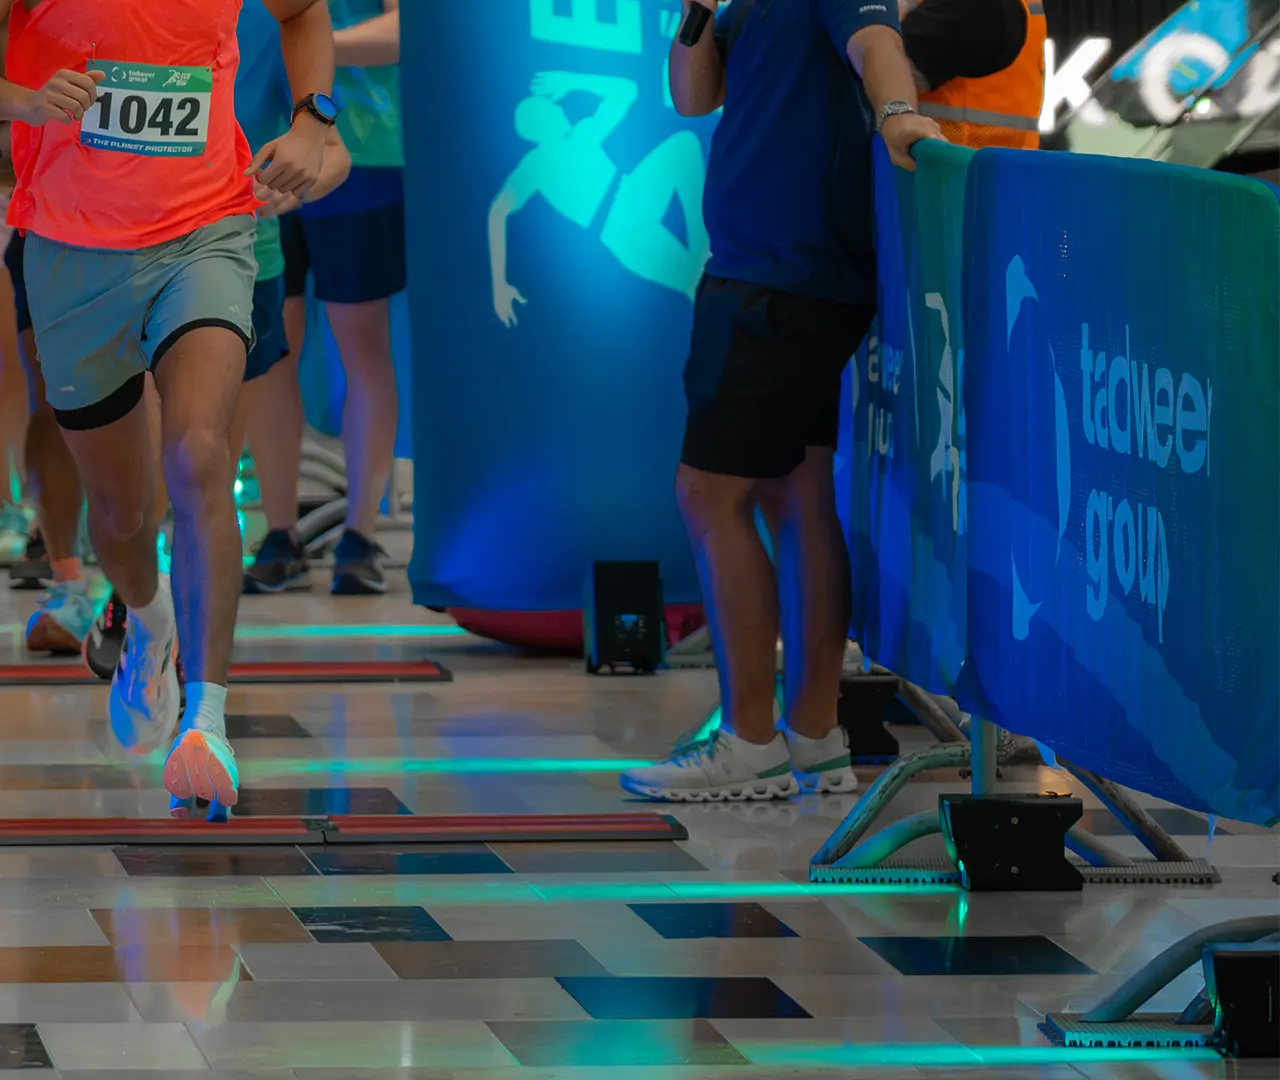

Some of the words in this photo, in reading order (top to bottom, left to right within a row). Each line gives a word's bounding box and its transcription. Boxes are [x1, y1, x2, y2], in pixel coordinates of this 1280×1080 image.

[96, 91, 201, 136] 1042
[93, 138, 110, 146] THE
[110, 141, 144, 151] PLANET
[145, 144, 193, 153] PROTECTOR
